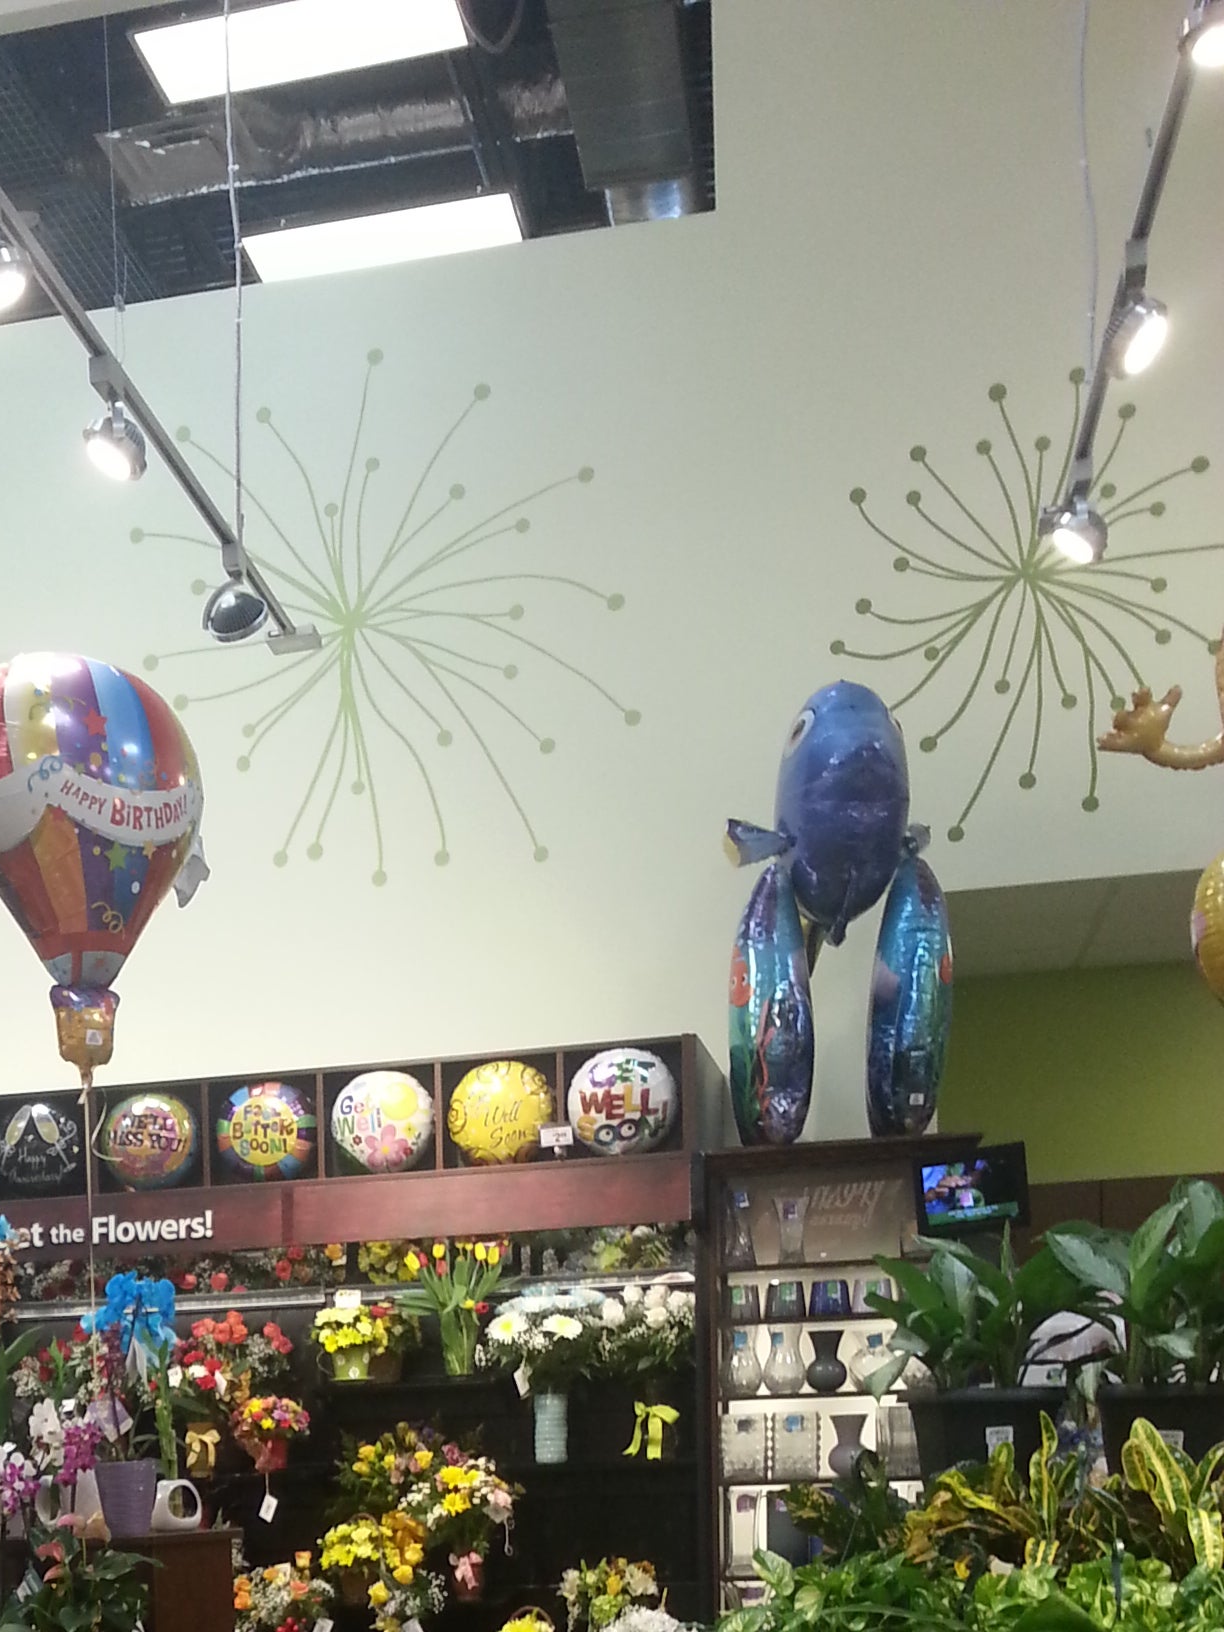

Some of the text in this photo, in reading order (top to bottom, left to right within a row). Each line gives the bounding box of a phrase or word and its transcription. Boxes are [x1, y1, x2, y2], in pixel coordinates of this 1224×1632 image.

[60, 779, 107, 816] HAPPY
[50, 1223, 85, 1245] the
[91, 1209, 213, 1245] Flowers!
